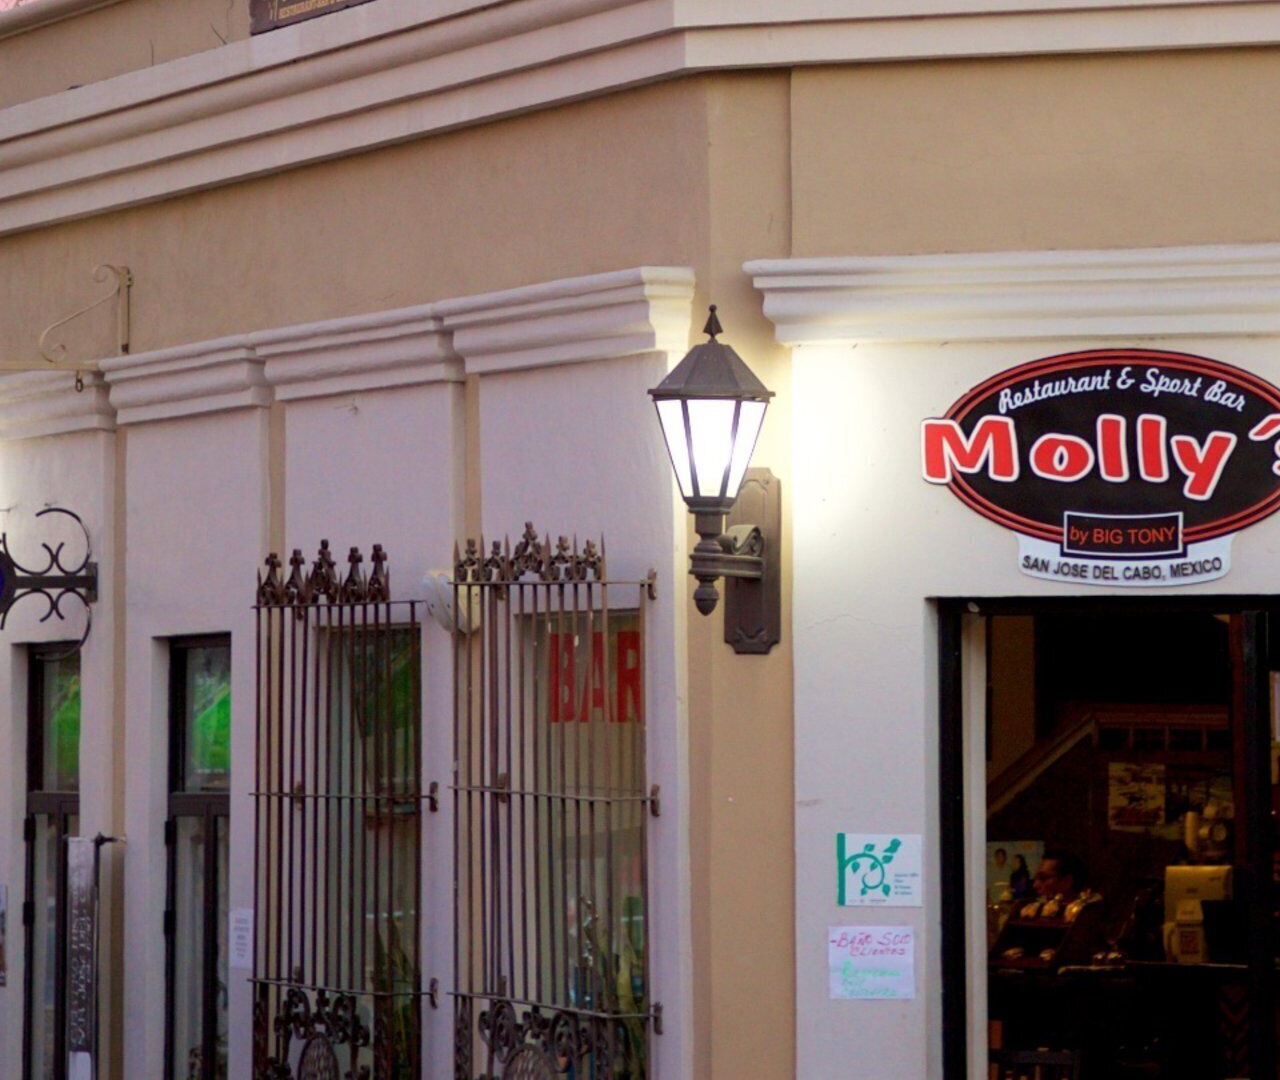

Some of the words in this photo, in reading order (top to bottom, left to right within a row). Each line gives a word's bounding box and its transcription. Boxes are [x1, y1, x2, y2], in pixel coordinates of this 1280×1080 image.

[999, 369, 1111, 414] Restaurant
[1116, 366, 1135, 390] &
[1140, 367, 1202, 397] Sport
[1204, 379, 1246, 412] Bar
[1070, 526, 1088, 545] by
[1092, 528, 1123, 545] BIG
[1127, 526, 1175, 545] TONY
[1022, 555, 1050, 571] SAN
[1053, 562, 1089, 579] JOSE
[1092, 566, 1119, 580] DEL
[1169, 557, 1222, 578] MEXICO
[549, 631, 642, 723] BAR
